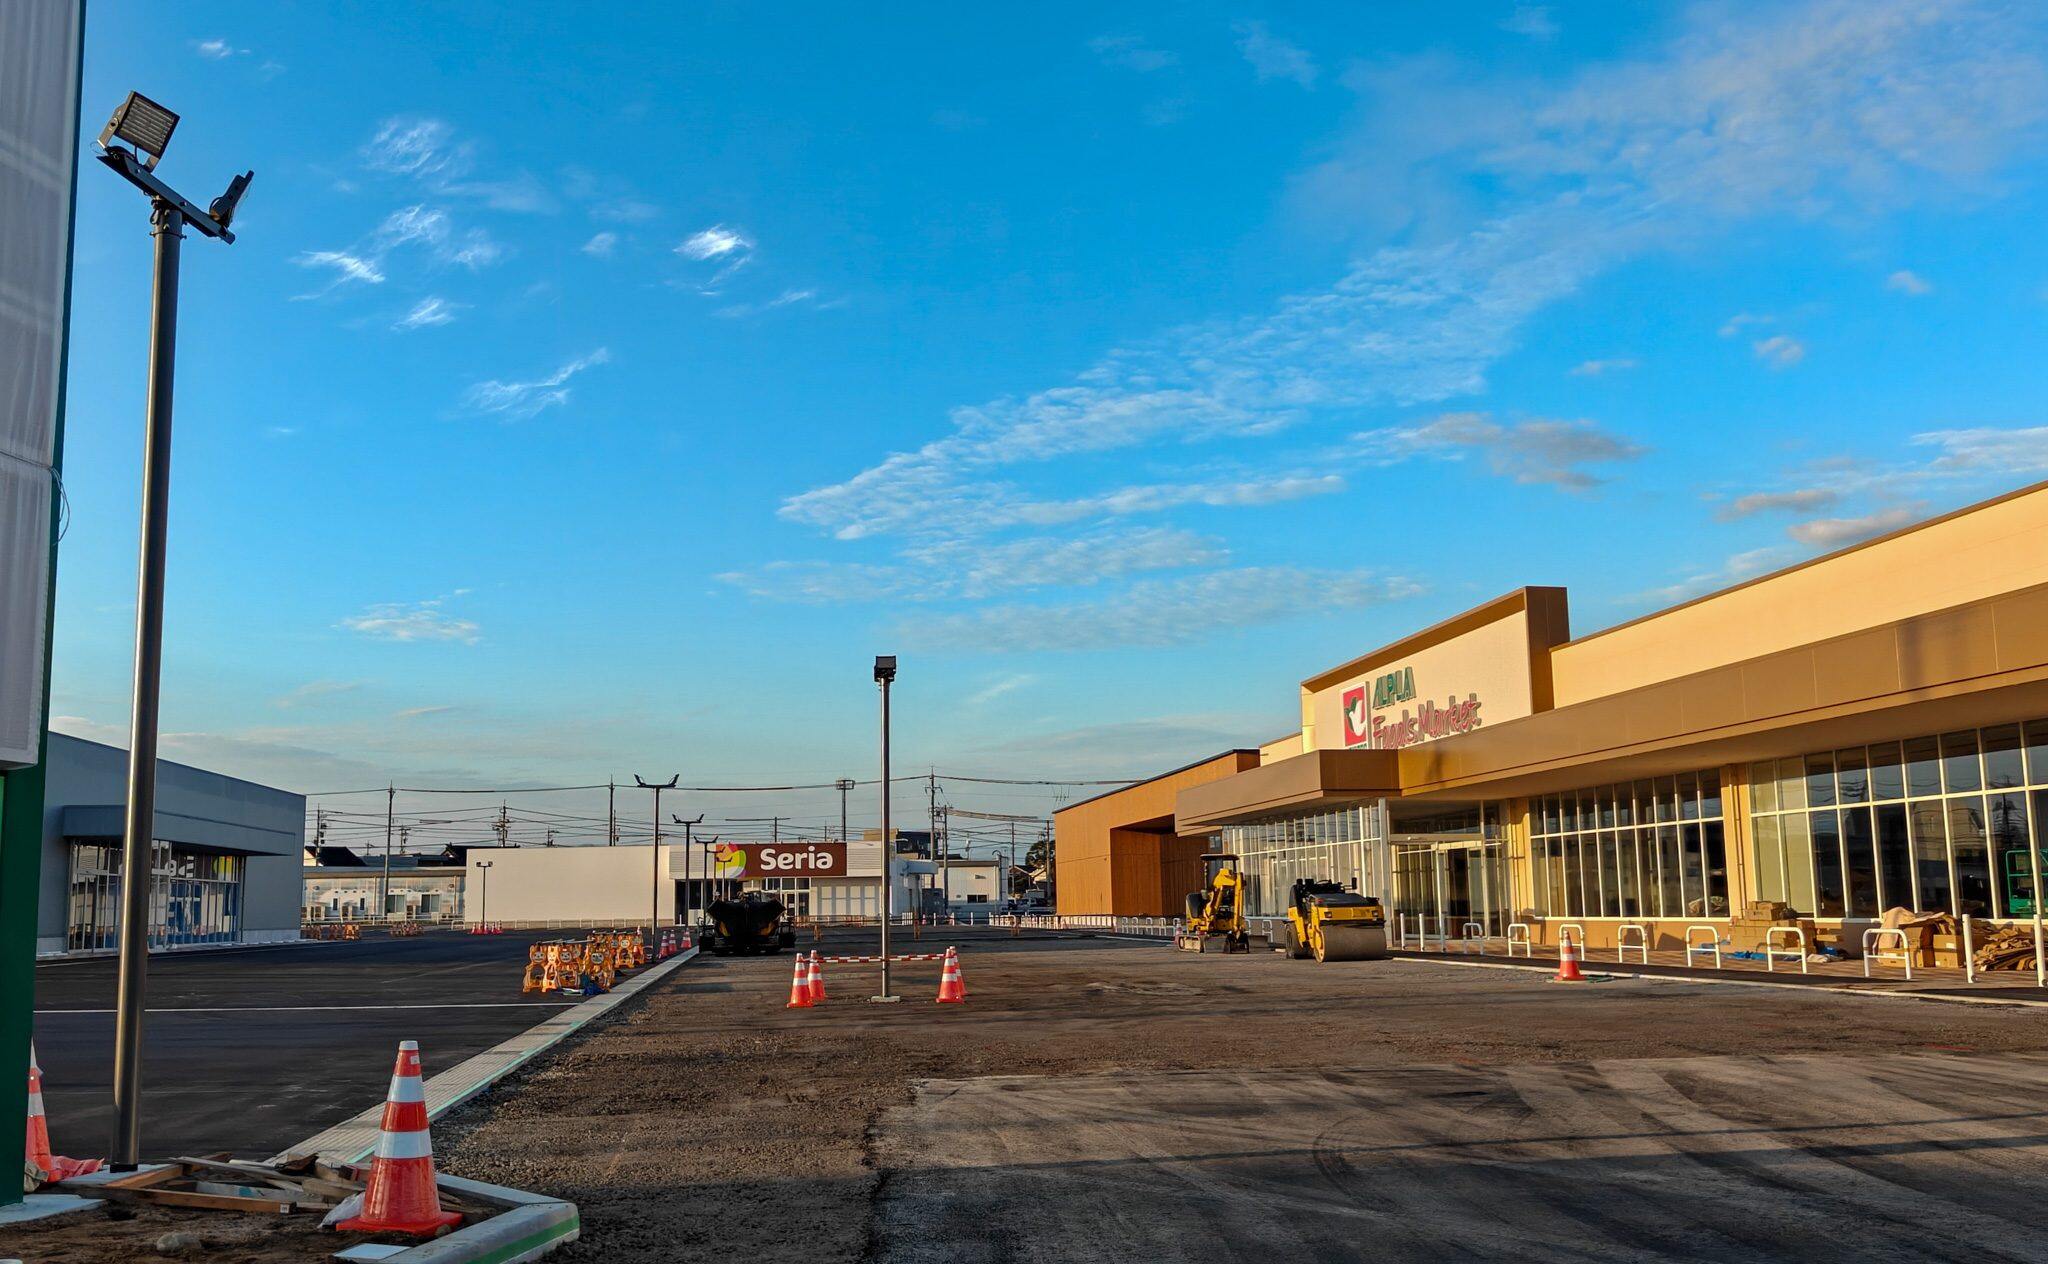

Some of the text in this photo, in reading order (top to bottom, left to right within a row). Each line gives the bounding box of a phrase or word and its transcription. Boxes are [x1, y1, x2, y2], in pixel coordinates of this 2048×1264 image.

[1373, 667, 1416, 709] ALPLA
[1373, 693, 1482, 749] Foods Market
[760, 846, 833, 871] Seria
